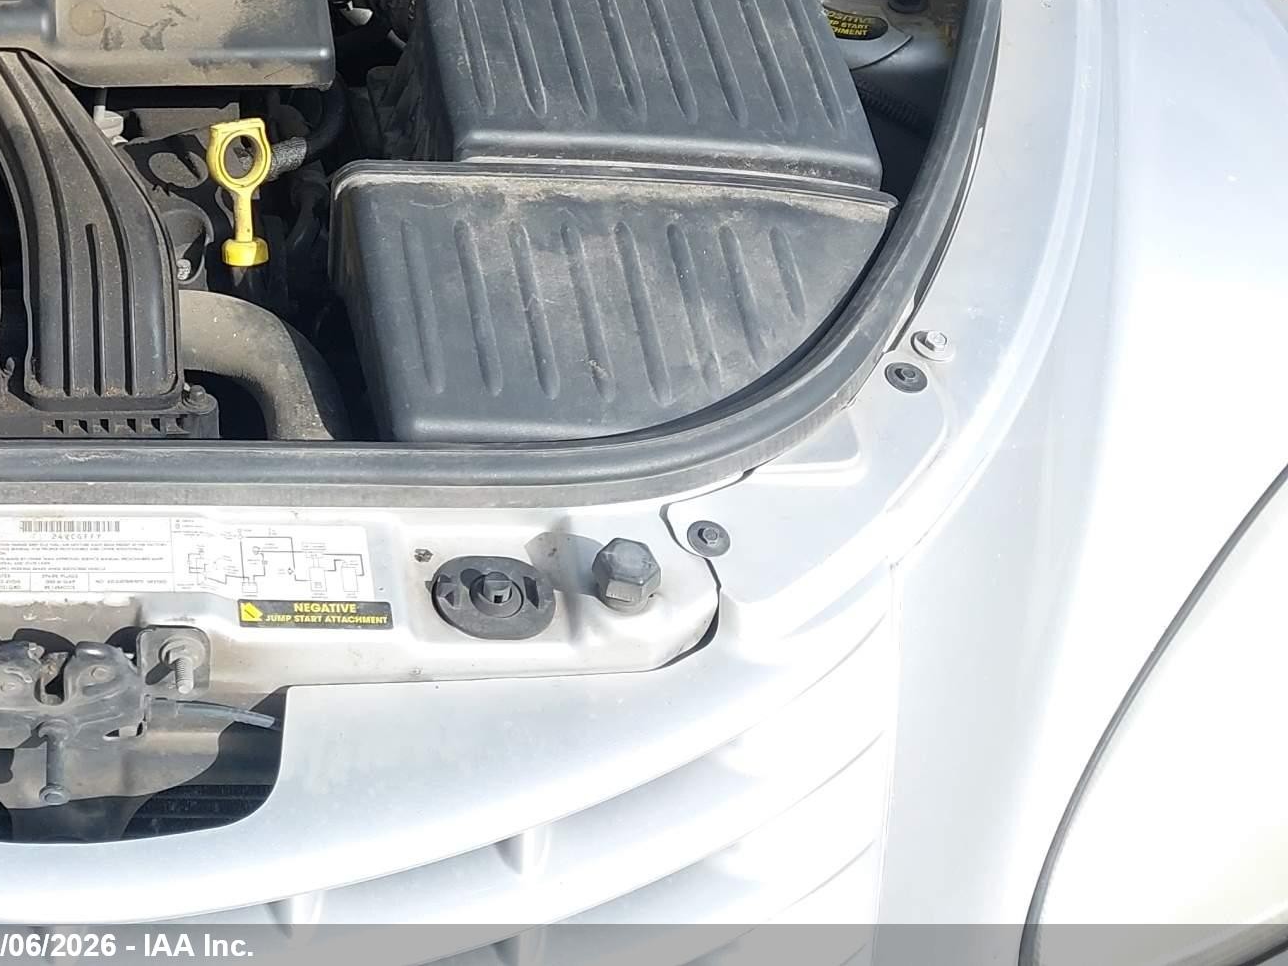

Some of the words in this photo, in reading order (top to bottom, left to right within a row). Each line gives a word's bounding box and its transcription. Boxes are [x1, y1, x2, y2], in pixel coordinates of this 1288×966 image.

[826, 10, 875, 24] OSITIVE
[293, 603, 357, 614] NEGATIVE
[265, 614, 293, 623] JUMP
[294, 614, 323, 623] START
[323, 614, 388, 625] ATTACHMENT
